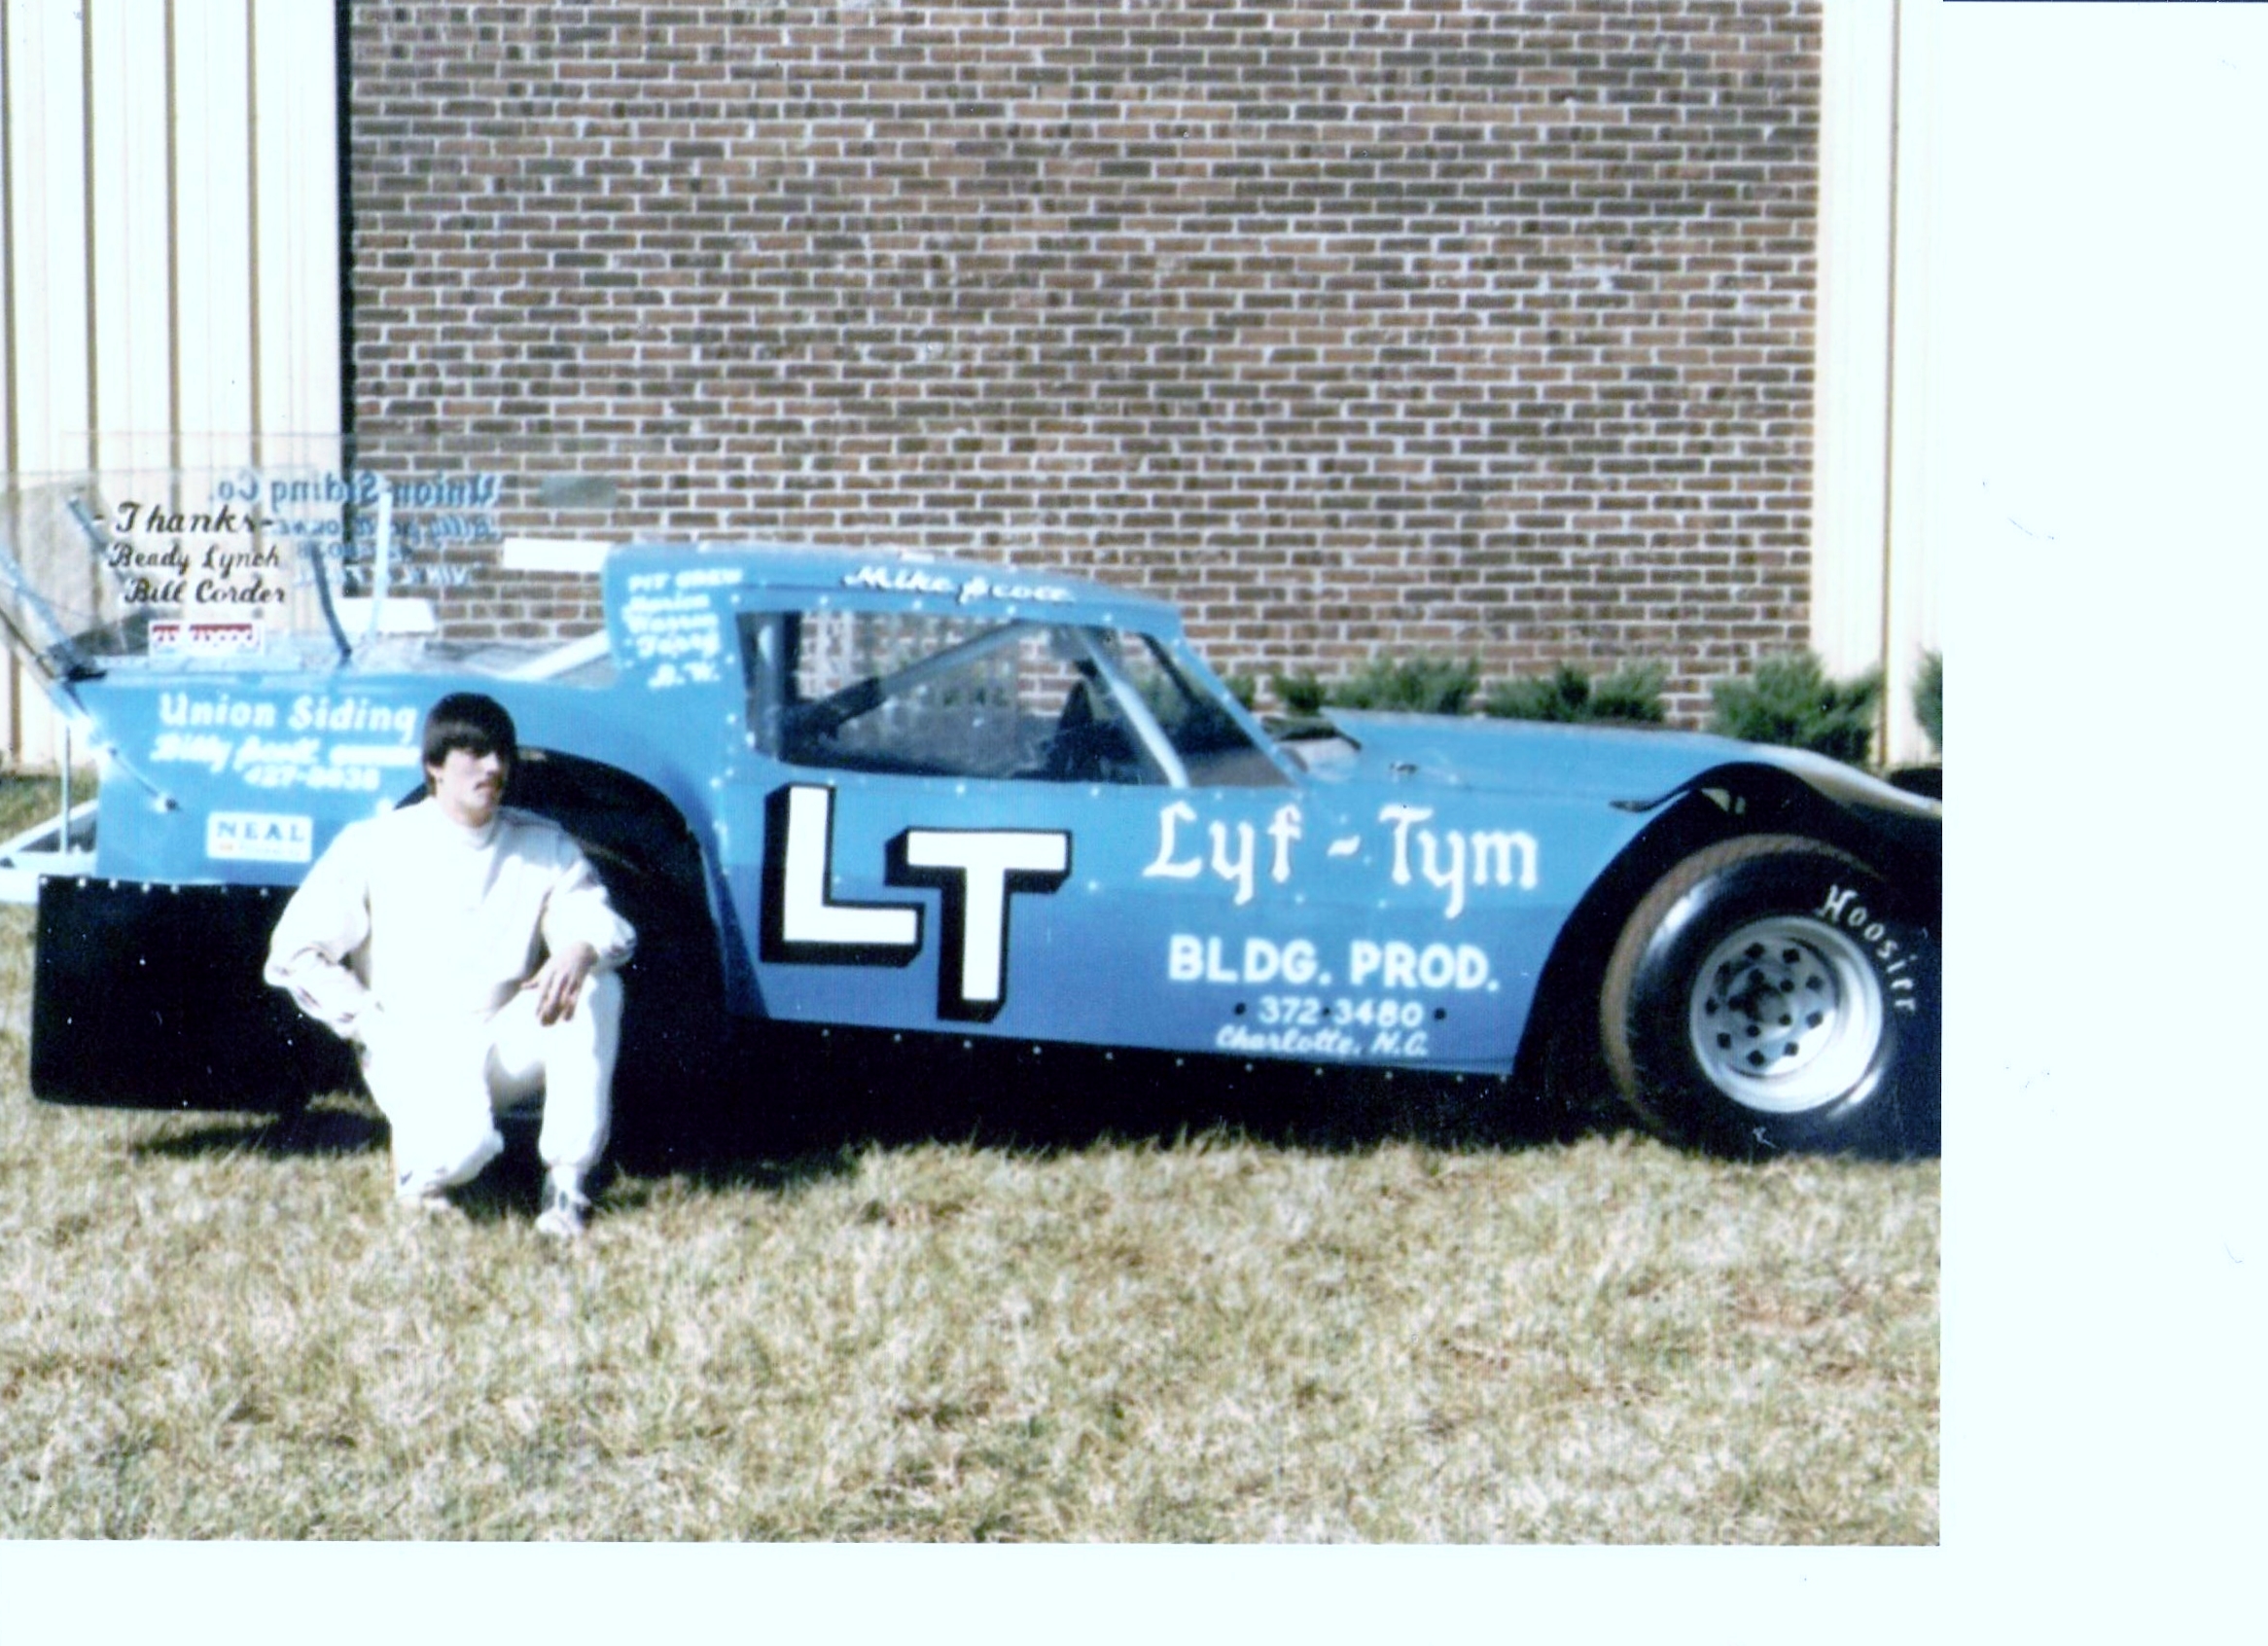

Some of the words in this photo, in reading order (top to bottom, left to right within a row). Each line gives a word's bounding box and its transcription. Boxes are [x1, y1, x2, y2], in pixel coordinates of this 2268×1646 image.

[201, 543, 280, 579] Lynch
[841, 565, 954, 590] Mike
[124, 577, 188, 604] Bill
[195, 576, 286, 604] Corder
[159, 691, 276, 728] Union
[288, 695, 418, 744] Siding
[216, 820, 305, 843] NEAL
[1142, 801, 1303, 906] Lyf
[1378, 804, 1539, 920] Tym
[1167, 934, 1333, 986] BLDG.
[1349, 940, 1501, 992] PROD.
